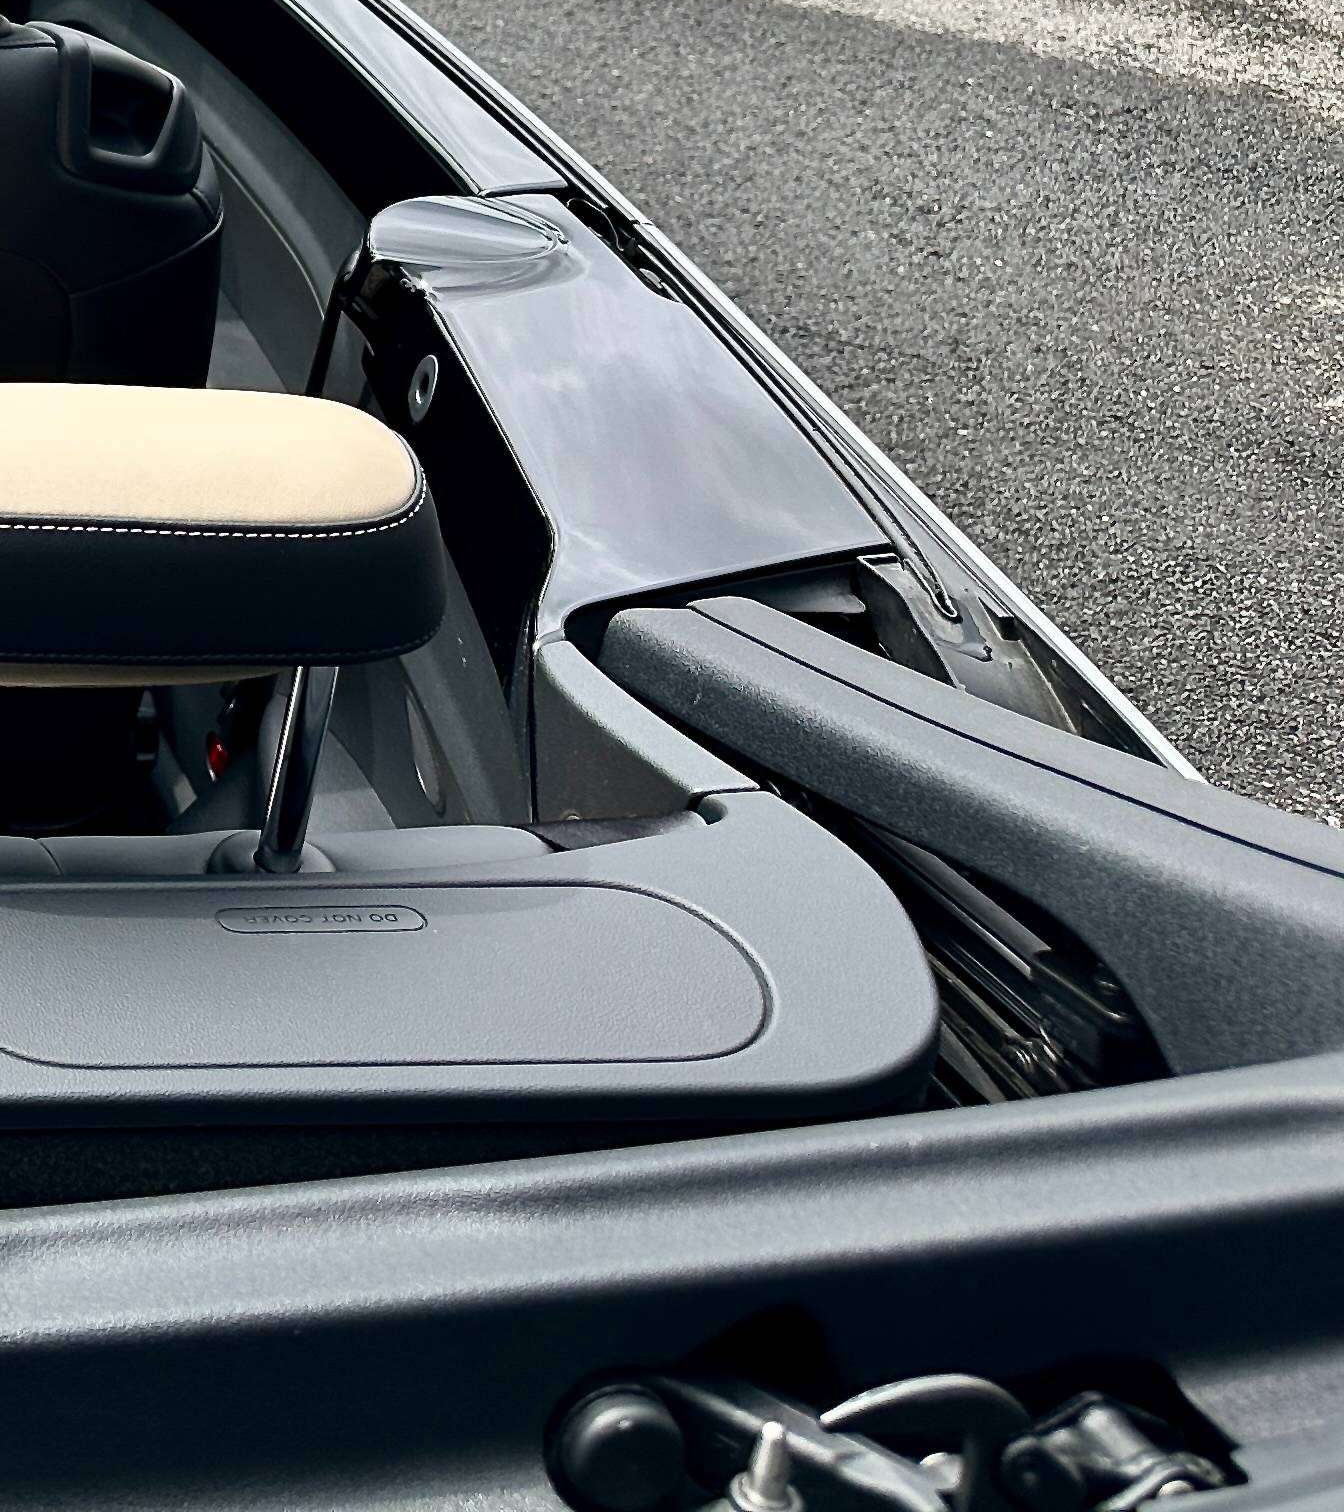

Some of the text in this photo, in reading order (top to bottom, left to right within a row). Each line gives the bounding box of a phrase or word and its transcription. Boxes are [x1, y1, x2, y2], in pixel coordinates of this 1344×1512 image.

[242, 913, 398, 924] DO NOT COVER
